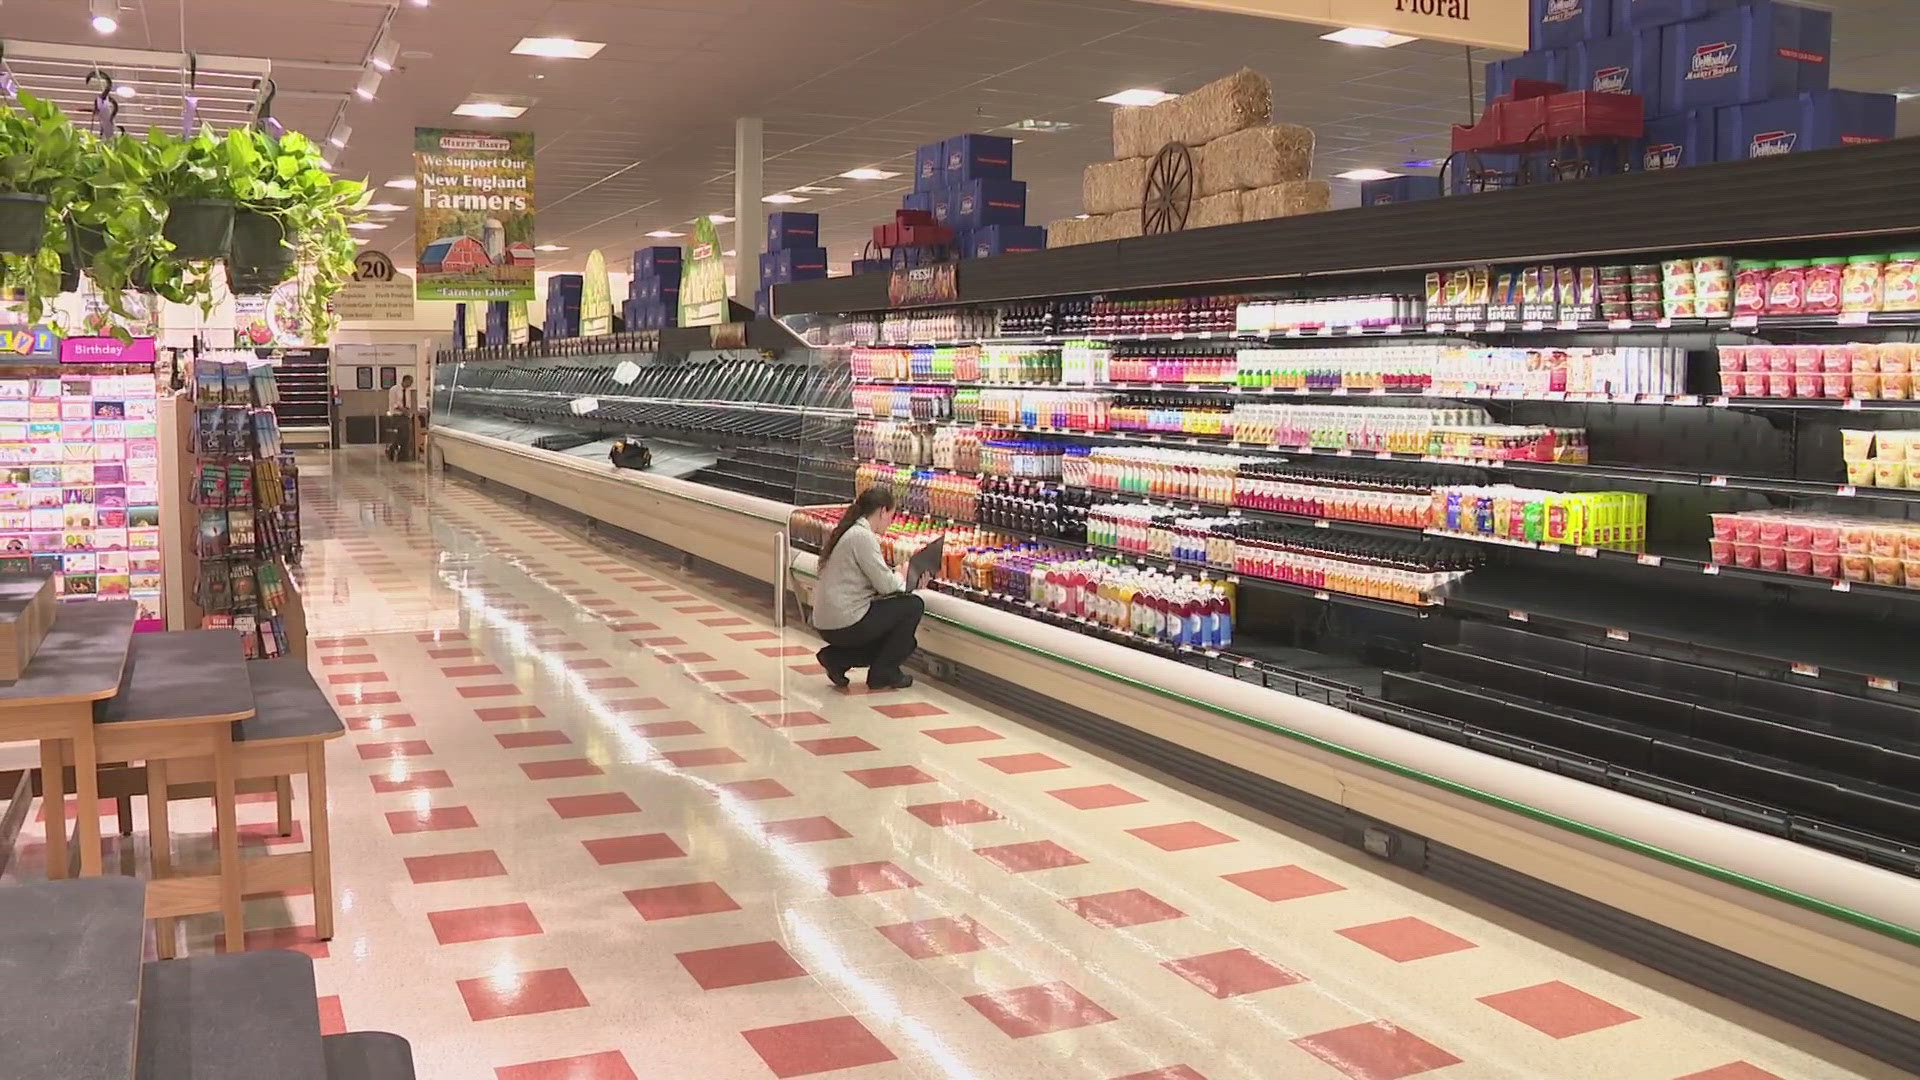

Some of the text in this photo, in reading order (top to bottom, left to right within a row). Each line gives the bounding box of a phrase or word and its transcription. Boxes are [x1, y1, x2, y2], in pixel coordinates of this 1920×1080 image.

[423, 155, 527, 170] We Support Our
[423, 172, 527, 192] New England
[423, 188, 527, 211] Farmers
[361, 261, 386, 279] 20
[75, 344, 123, 357] Birthday
